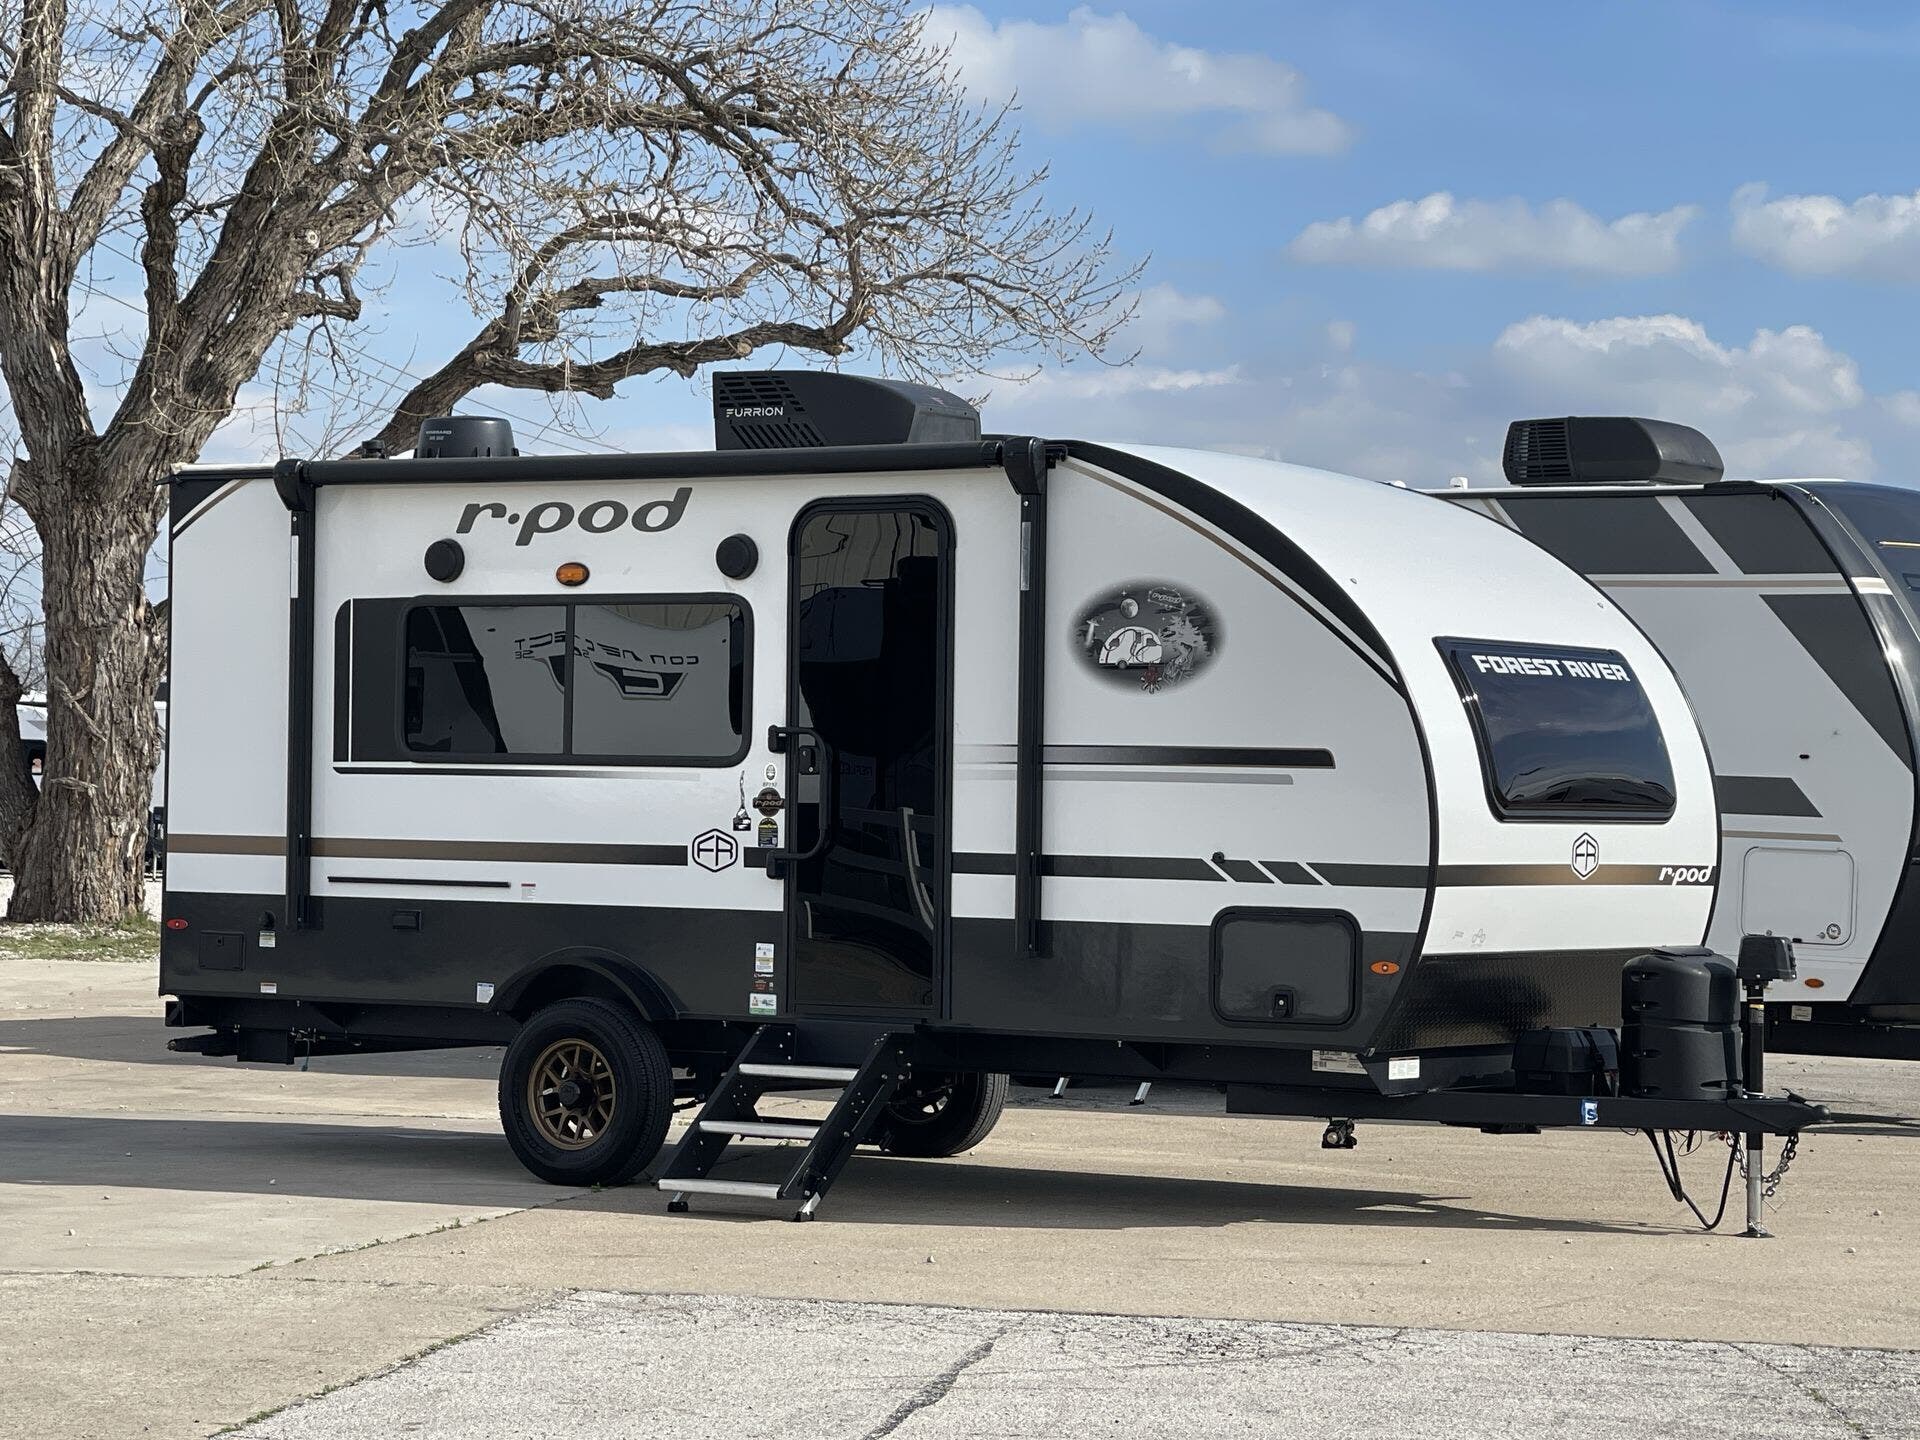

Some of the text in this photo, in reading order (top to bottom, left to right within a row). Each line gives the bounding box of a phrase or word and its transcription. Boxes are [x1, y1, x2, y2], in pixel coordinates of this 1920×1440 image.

[725, 406, 784, 418] FURRION
[1471, 654, 1631, 682] FOREST RIVER
